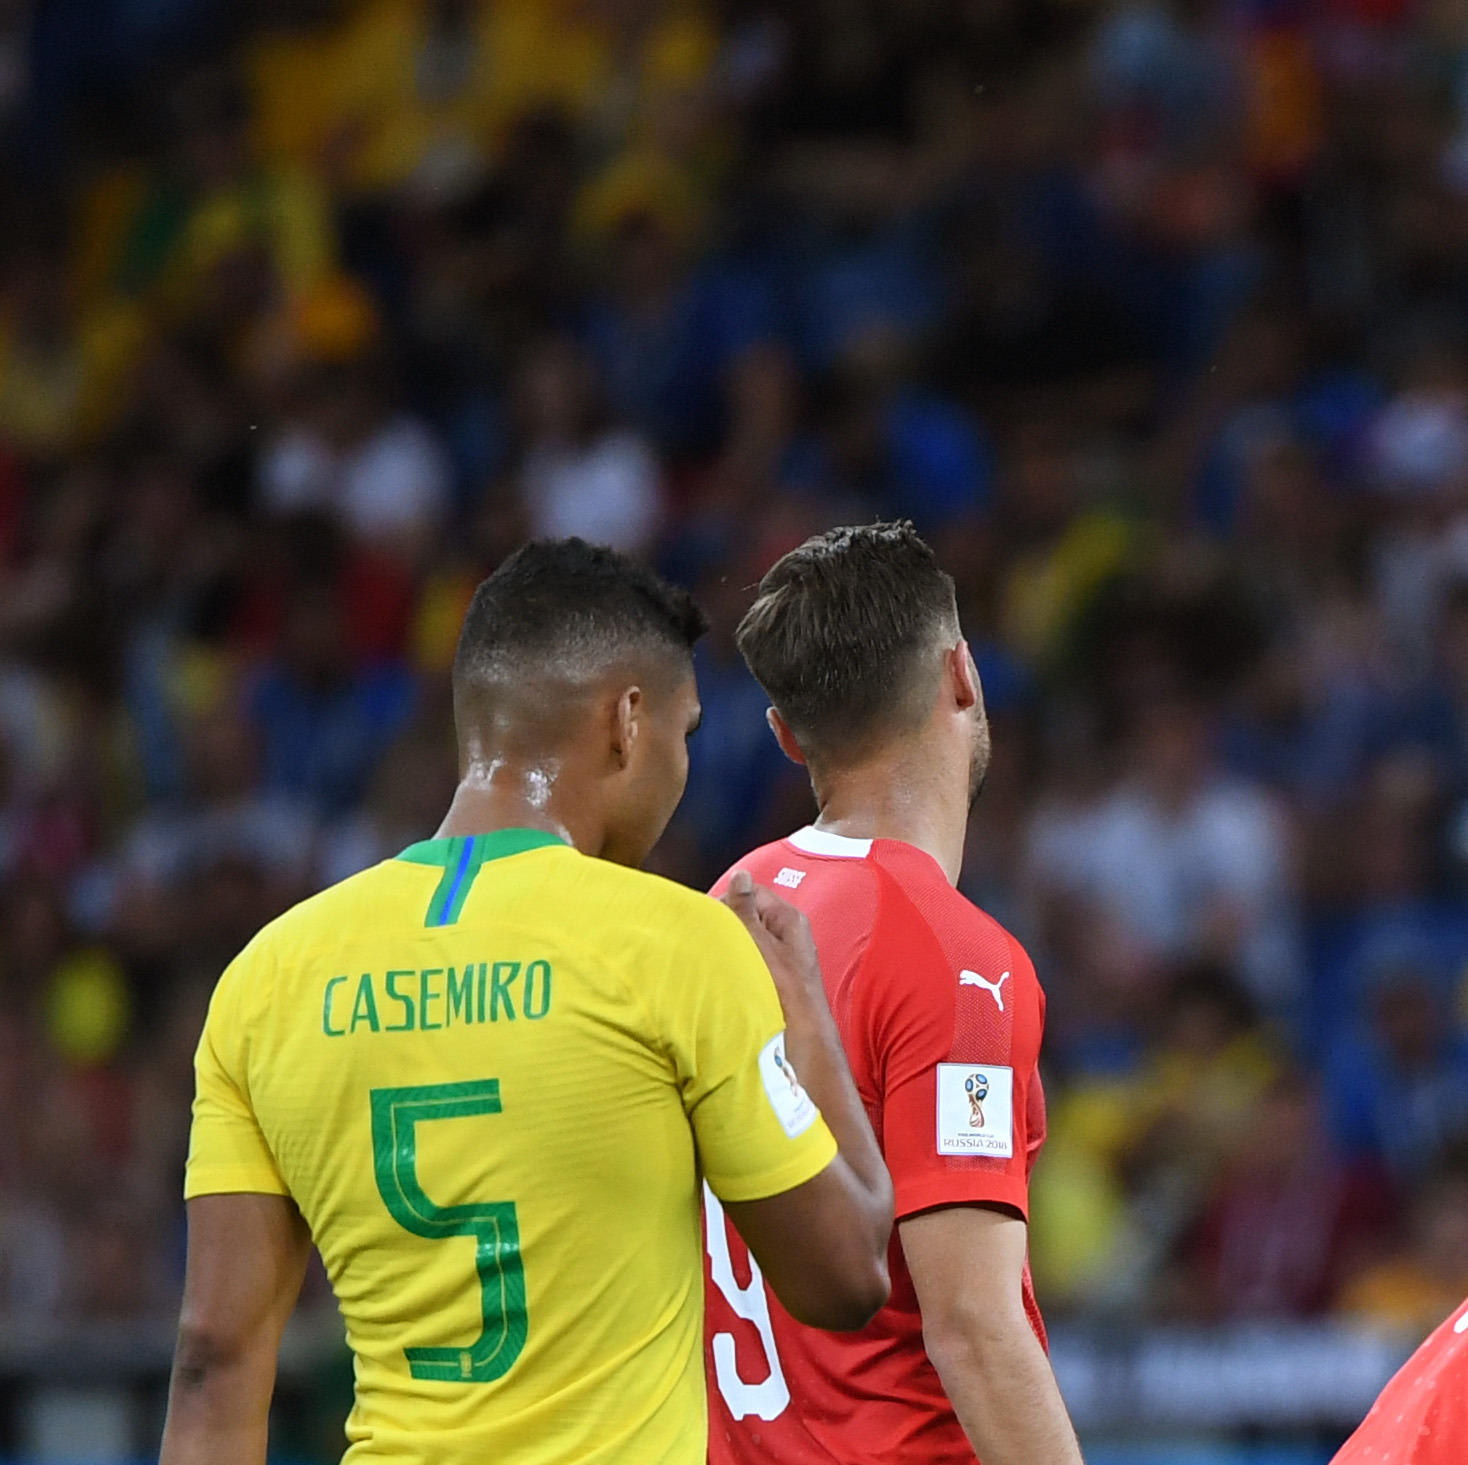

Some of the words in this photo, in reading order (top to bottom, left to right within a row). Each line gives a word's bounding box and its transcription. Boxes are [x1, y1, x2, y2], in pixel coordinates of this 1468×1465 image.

[323, 960, 552, 1037] CASEMIRO
[943, 1138, 983, 1148] RUSSIA
[370, 1078, 528, 1383] 5
[703, 1176, 792, 1421] 9
